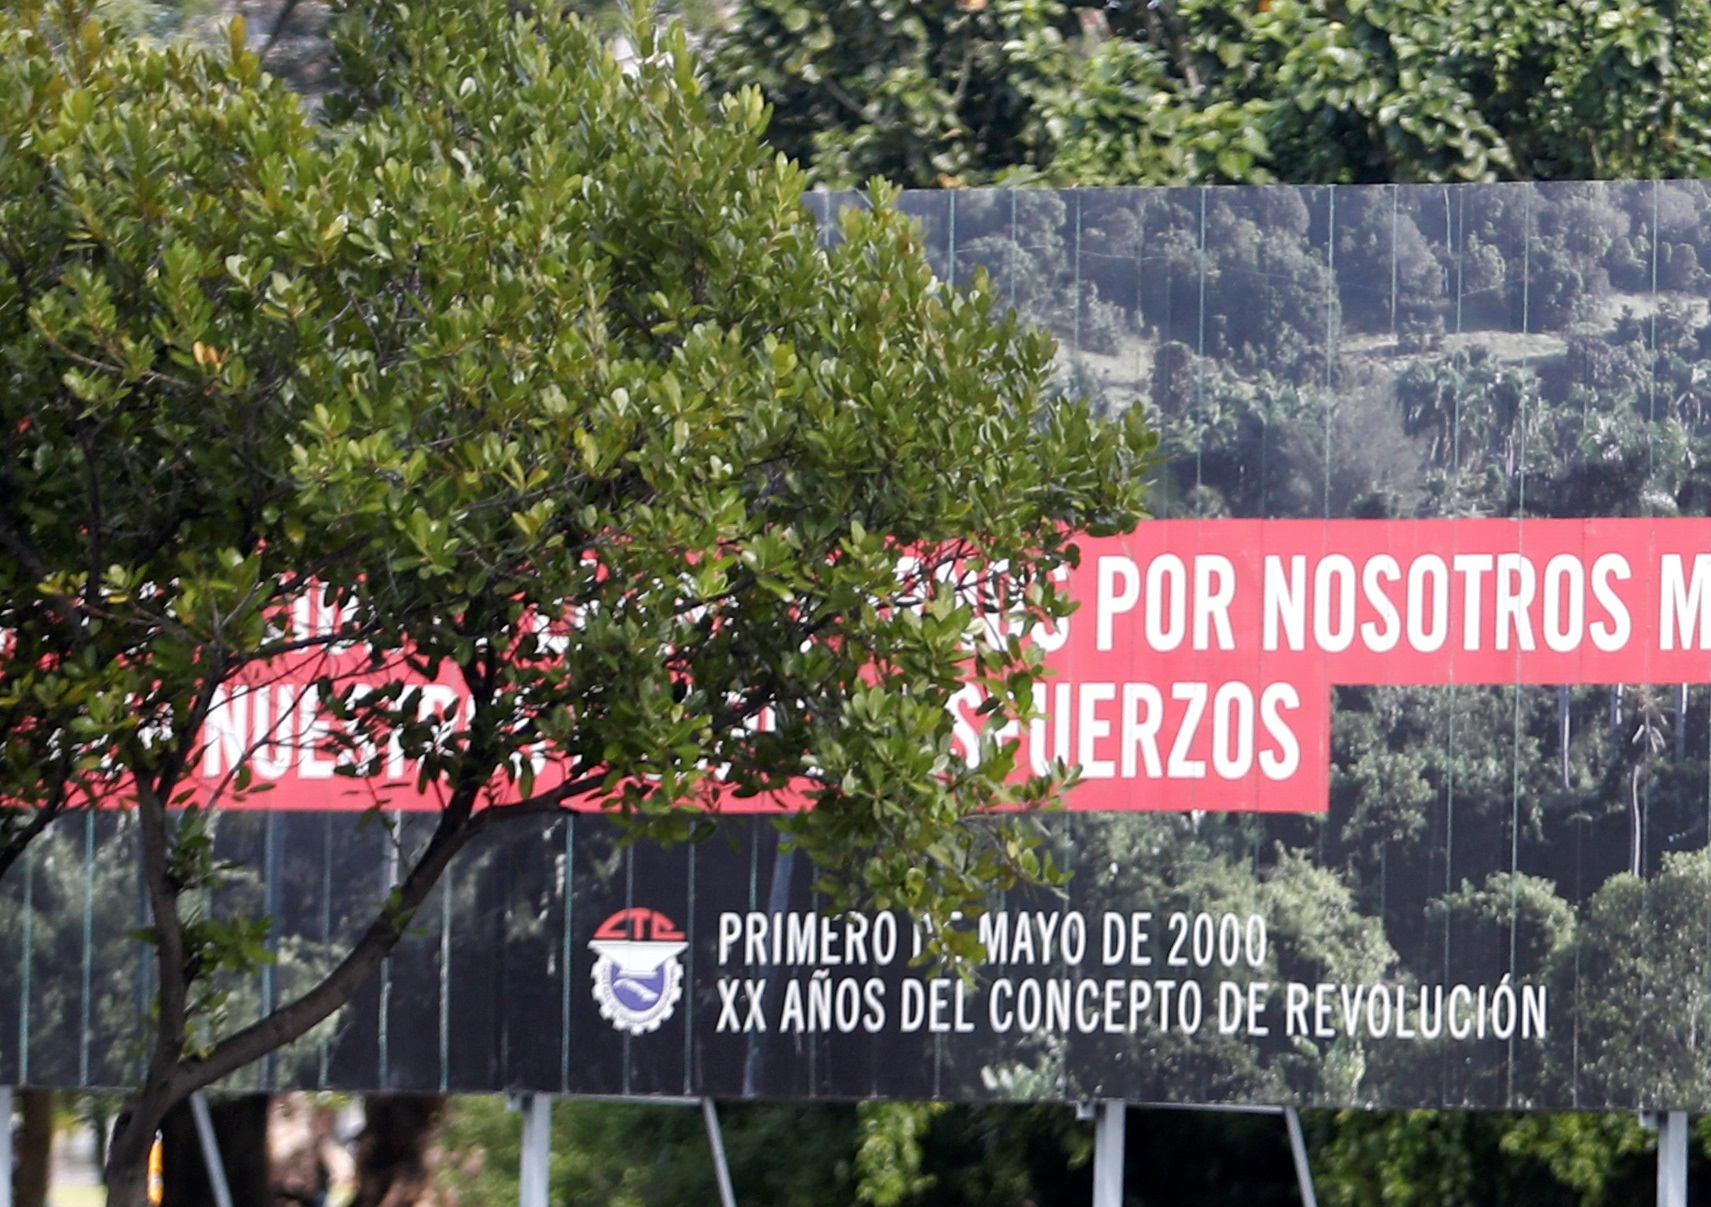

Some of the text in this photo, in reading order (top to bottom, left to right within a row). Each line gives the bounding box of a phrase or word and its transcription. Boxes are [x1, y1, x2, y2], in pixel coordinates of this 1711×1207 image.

[1096, 552, 1236, 653] POR
[1262, 552, 1633, 654] NOSOTROS
[902, 680, 1301, 781] SUERZOS
[718, 909, 898, 966] PRIMERO
[978, 910, 1087, 966] MAYO
[1101, 911, 1153, 966] DE
[1167, 911, 1268, 967] 2000
[715, 977, 767, 1033] XX
[779, 969, 886, 1033] AÑOS
[900, 977, 975, 1033] DEL
[988, 977, 1203, 1034] CONCEPTO
[1217, 980, 1271, 1037] DE
[1285, 972, 1547, 1040] REVOLUCIÓN
